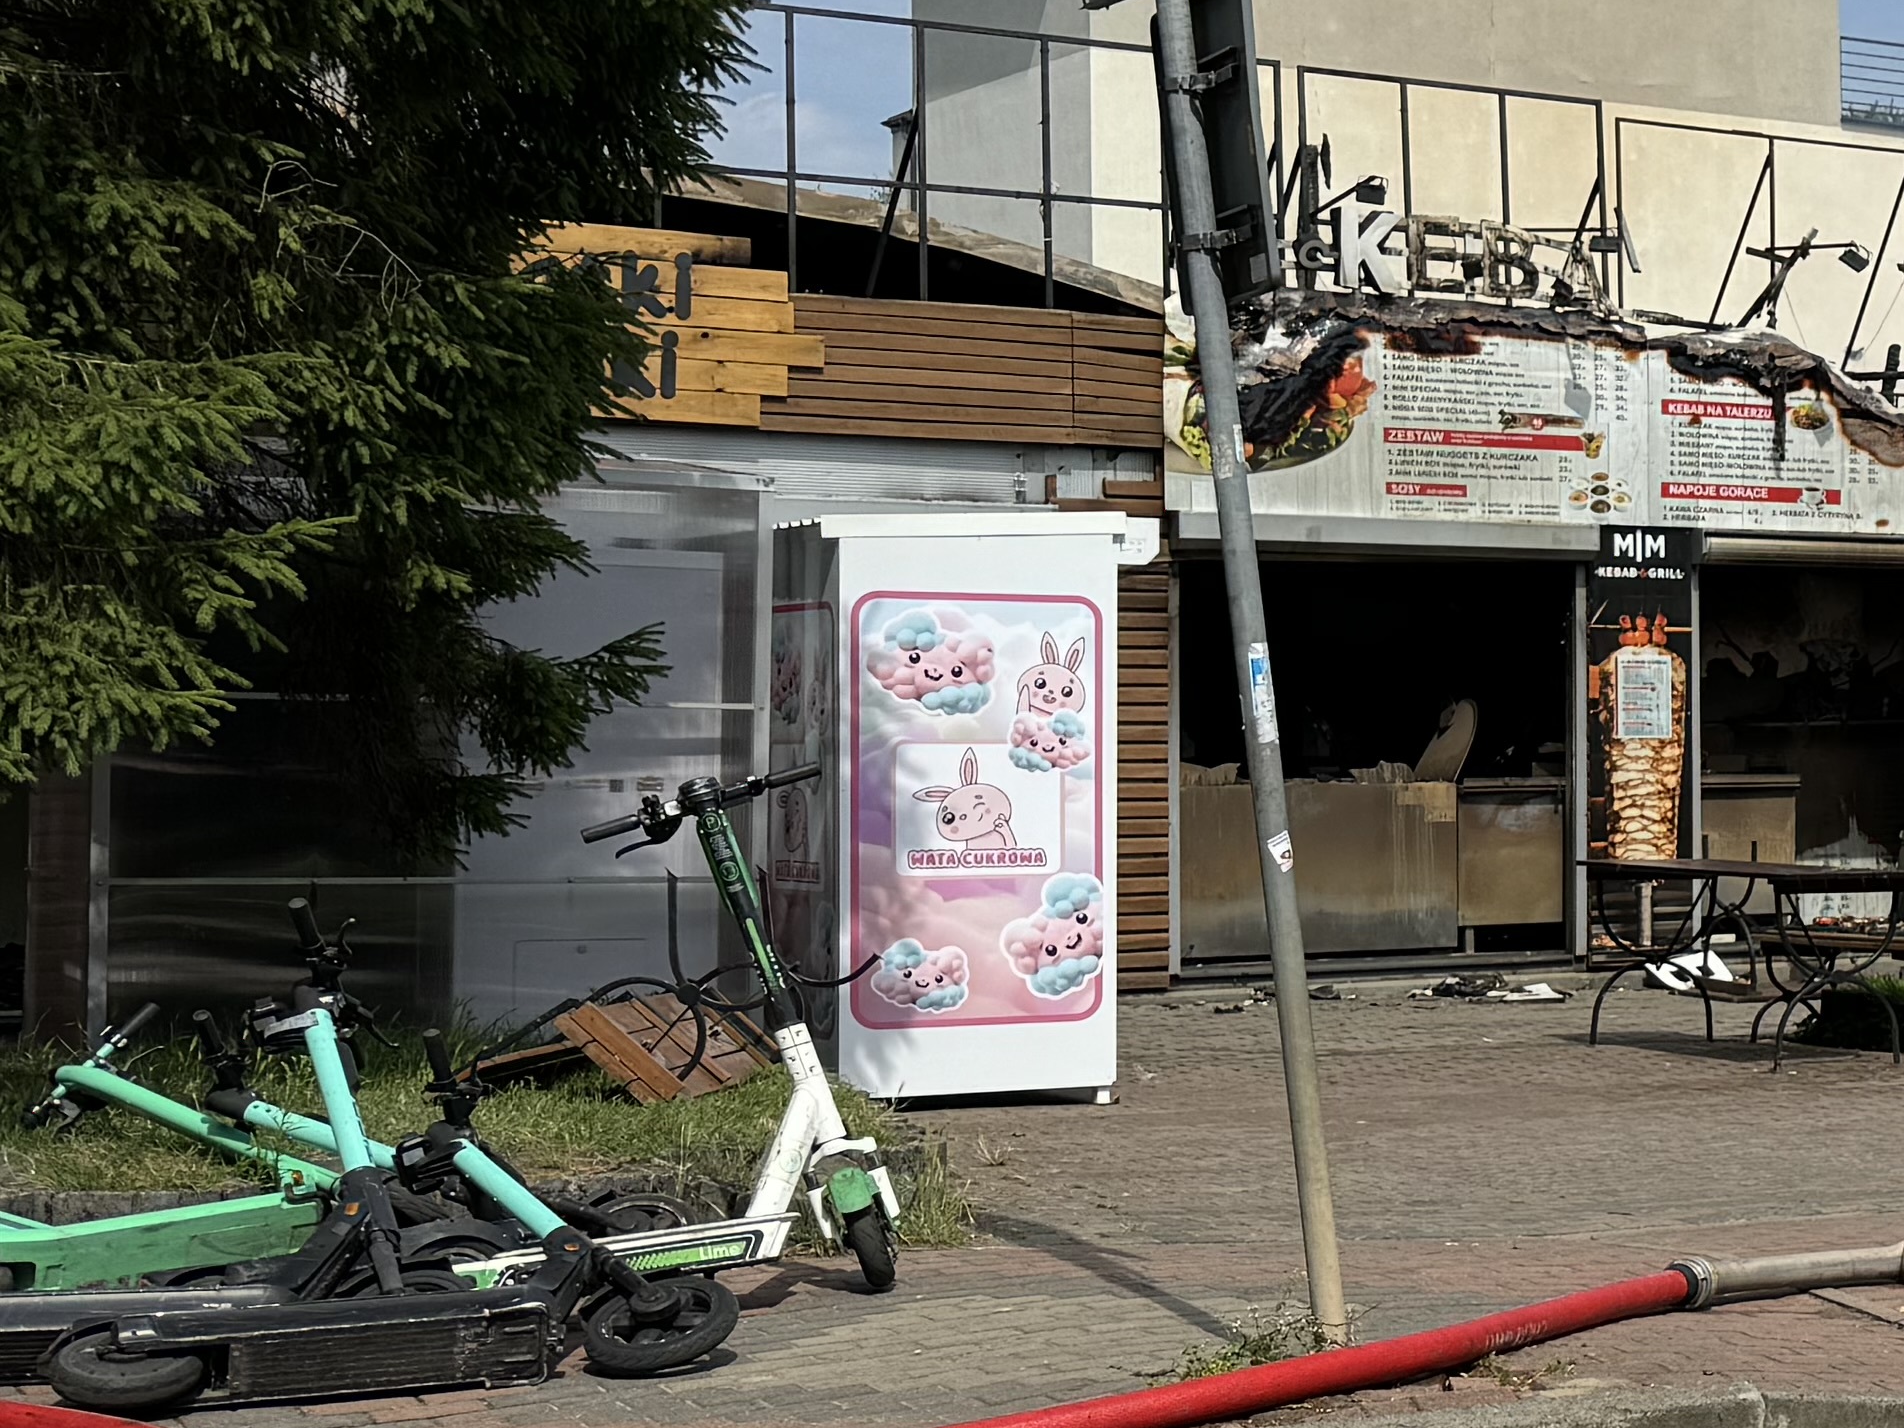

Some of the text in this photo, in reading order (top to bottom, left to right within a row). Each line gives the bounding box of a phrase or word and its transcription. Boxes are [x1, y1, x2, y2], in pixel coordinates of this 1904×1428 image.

[1668, 403, 1772, 418] KEBAB NA TALERZU
[1388, 430, 1445, 443] ZESTAW
[1669, 484, 1768, 500] NAPOJE GORĄCE
[1648, 567, 1684, 580] GRILL
[909, 850, 1046, 867] WATA CUKROWA
[699, 1244, 741, 1261] Lime
